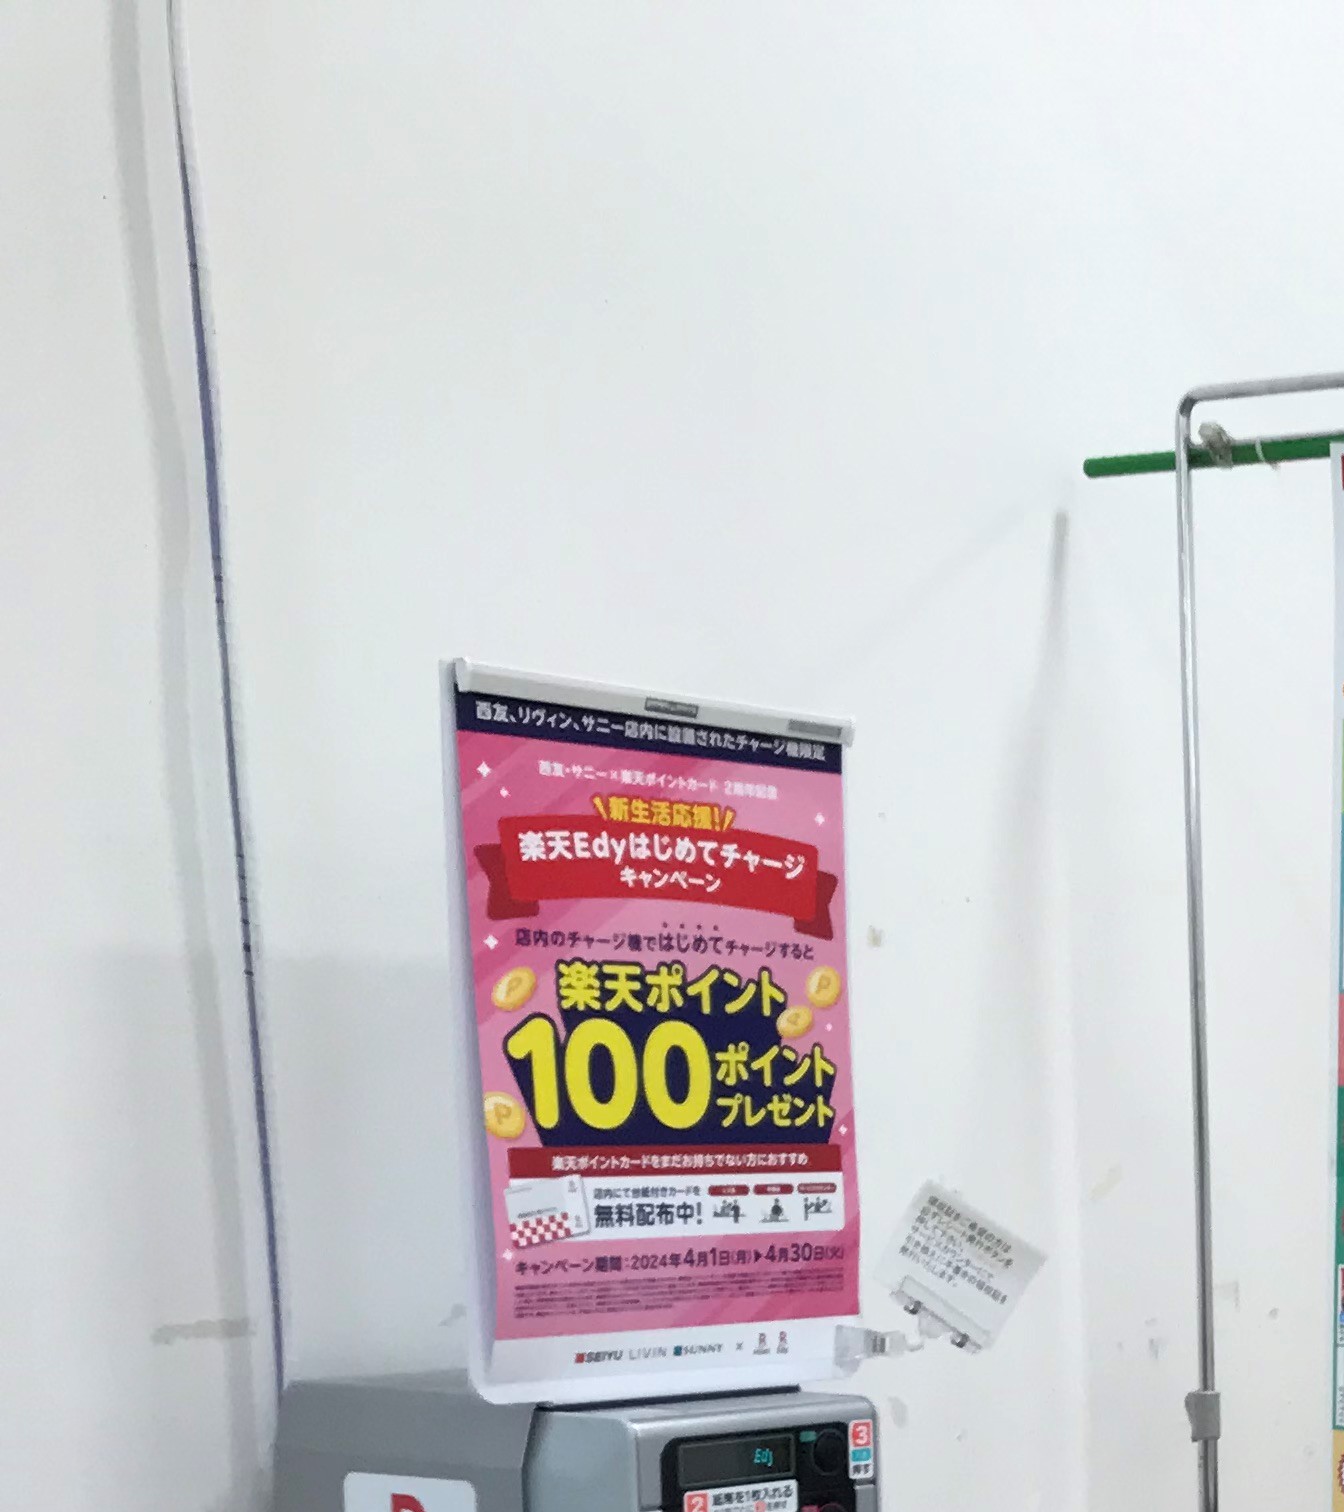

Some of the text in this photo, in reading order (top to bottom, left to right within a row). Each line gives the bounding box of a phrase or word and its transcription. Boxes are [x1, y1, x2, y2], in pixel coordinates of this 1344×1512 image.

[518, 831, 804, 879] 楽天Edyはじめてチャージ
[620, 868, 720, 892] キャンペーン
[558, 961, 786, 1016] 楽天ポイント
[506, 1017, 712, 1130] 100
[715, 1043, 834, 1087] ポイント
[715, 1094, 834, 1128] プレゼント
[856, 1424, 868, 1444] 3
[754, 1448, 773, 1467] Edy
